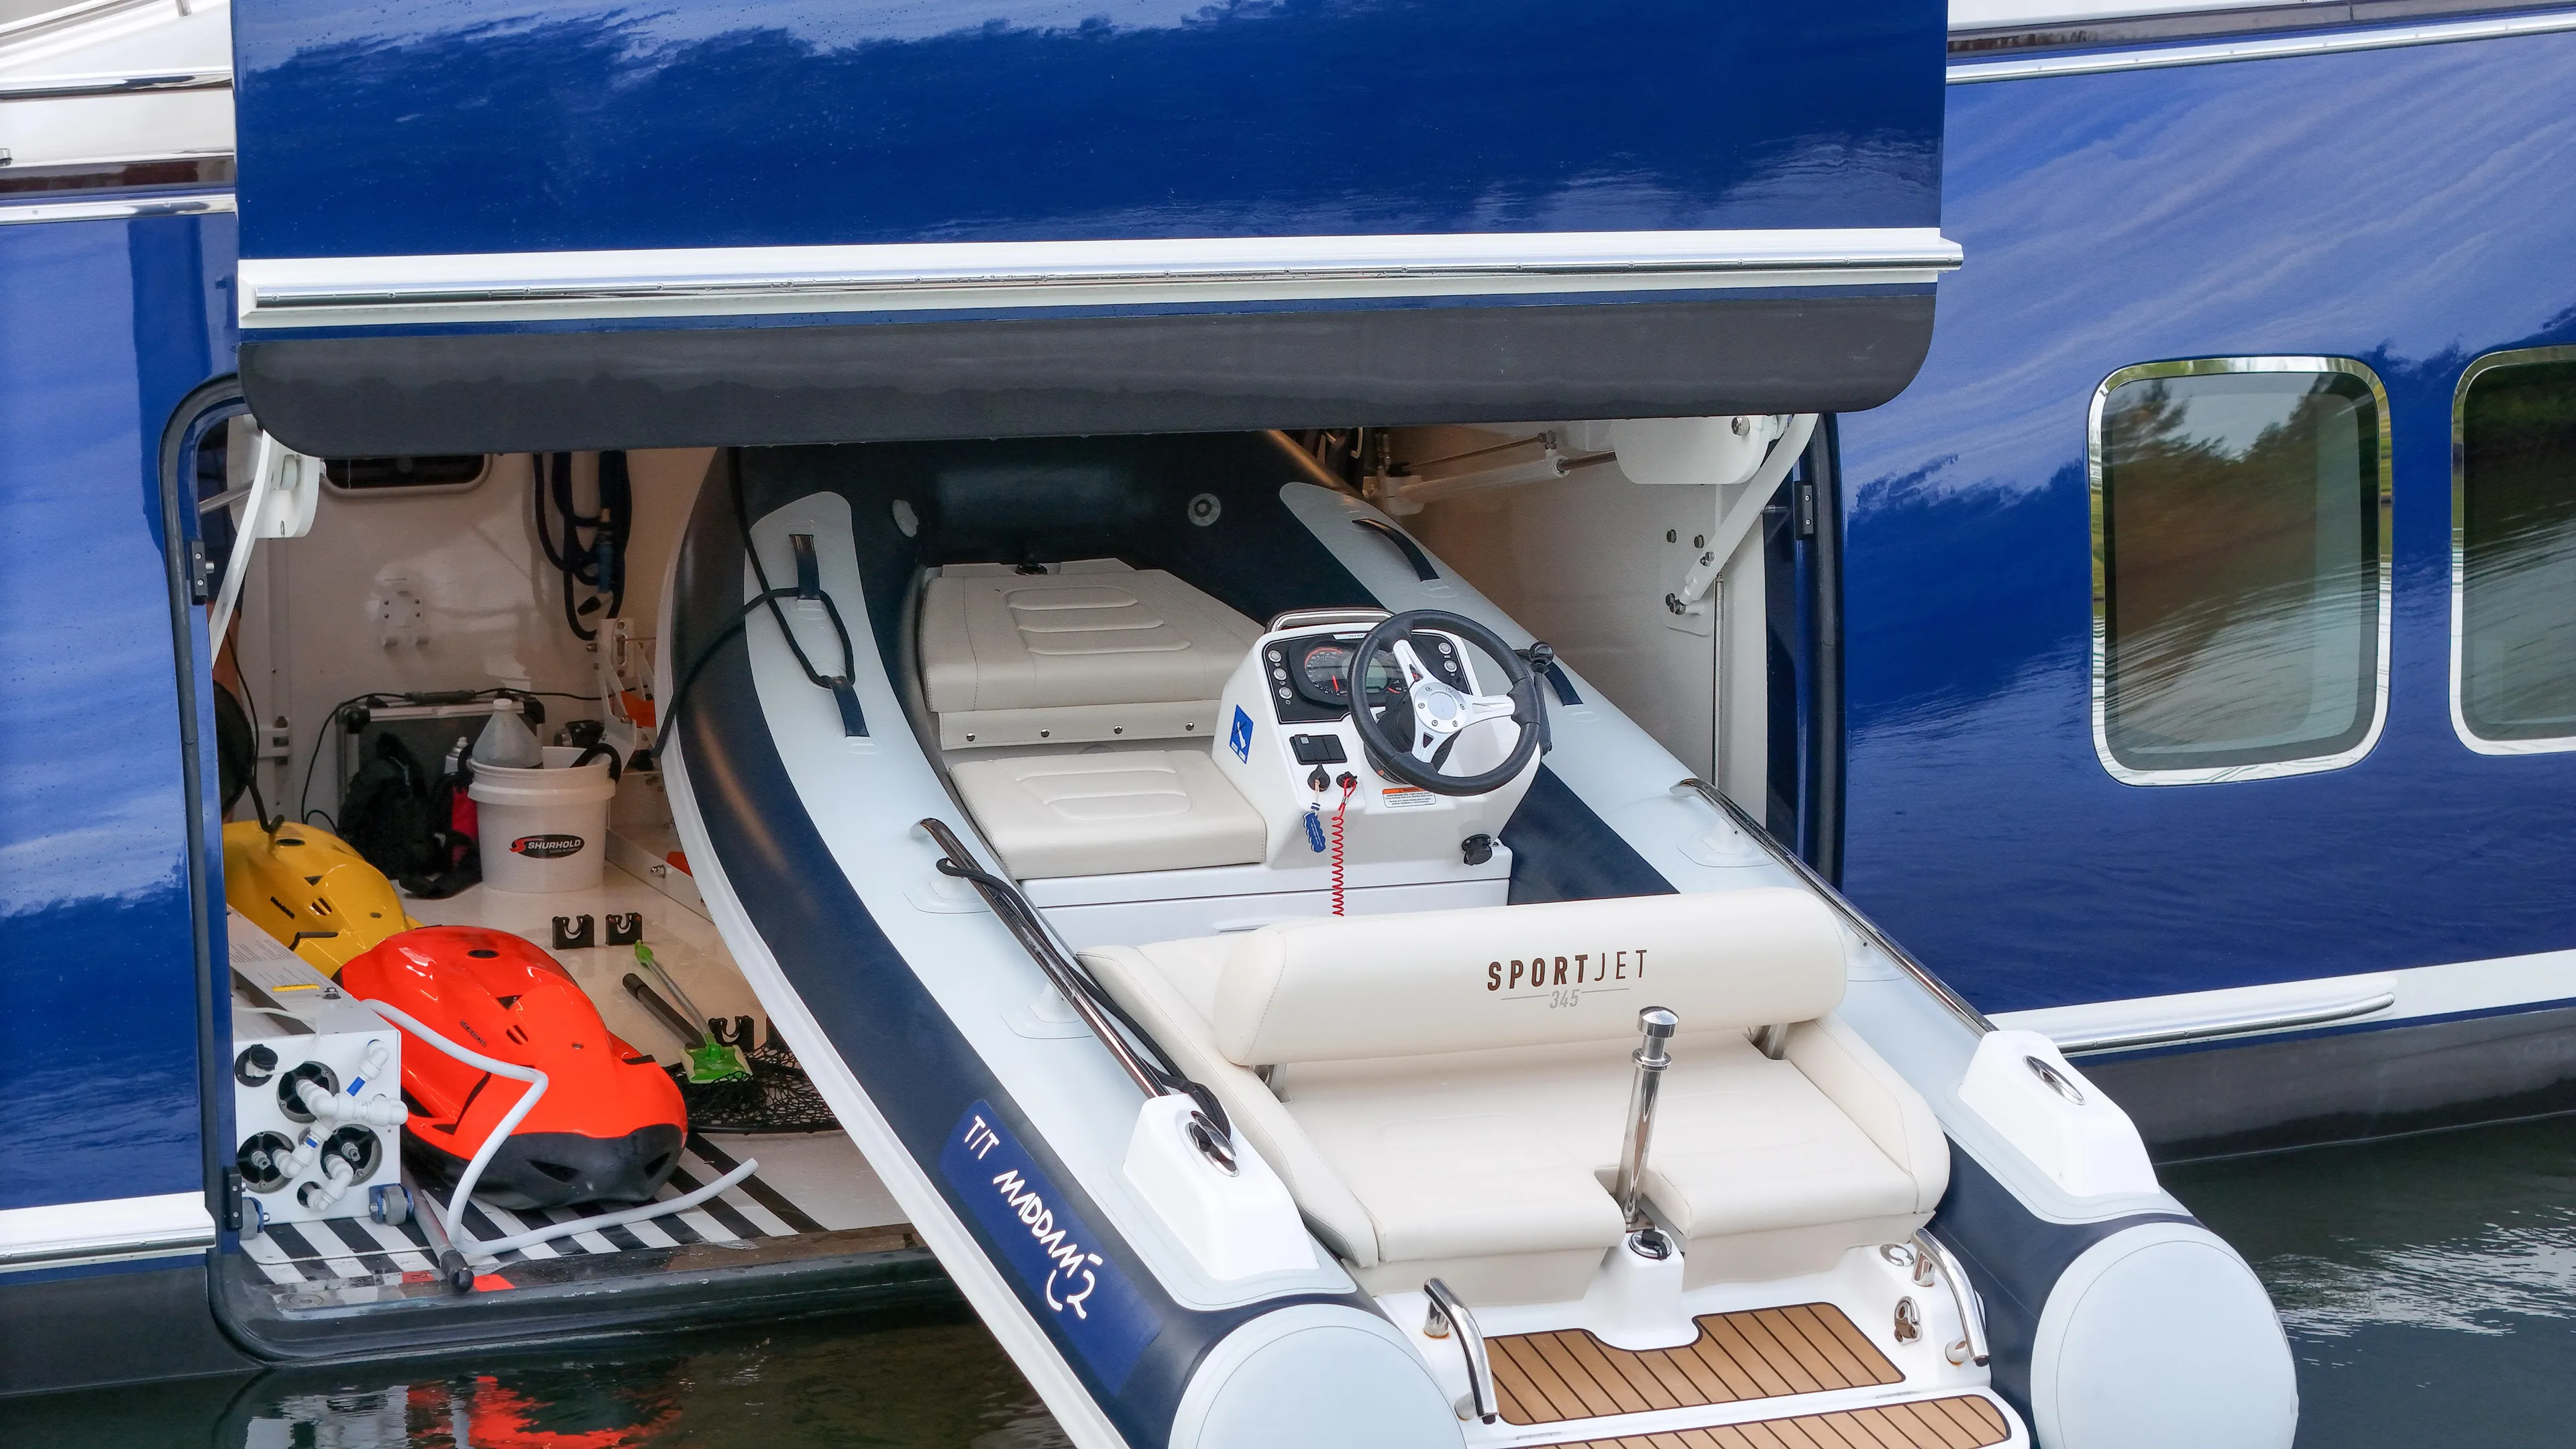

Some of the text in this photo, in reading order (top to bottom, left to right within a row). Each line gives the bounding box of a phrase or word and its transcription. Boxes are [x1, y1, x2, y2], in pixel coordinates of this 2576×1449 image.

[528, 839, 581, 849] SHURHOLD
[1550, 989, 1580, 1009] 345
[460, 1020, 486, 1046] SEABOB
[965, 1115, 1000, 1160] T/T
[993, 1169, 1085, 1278] MADDAM
